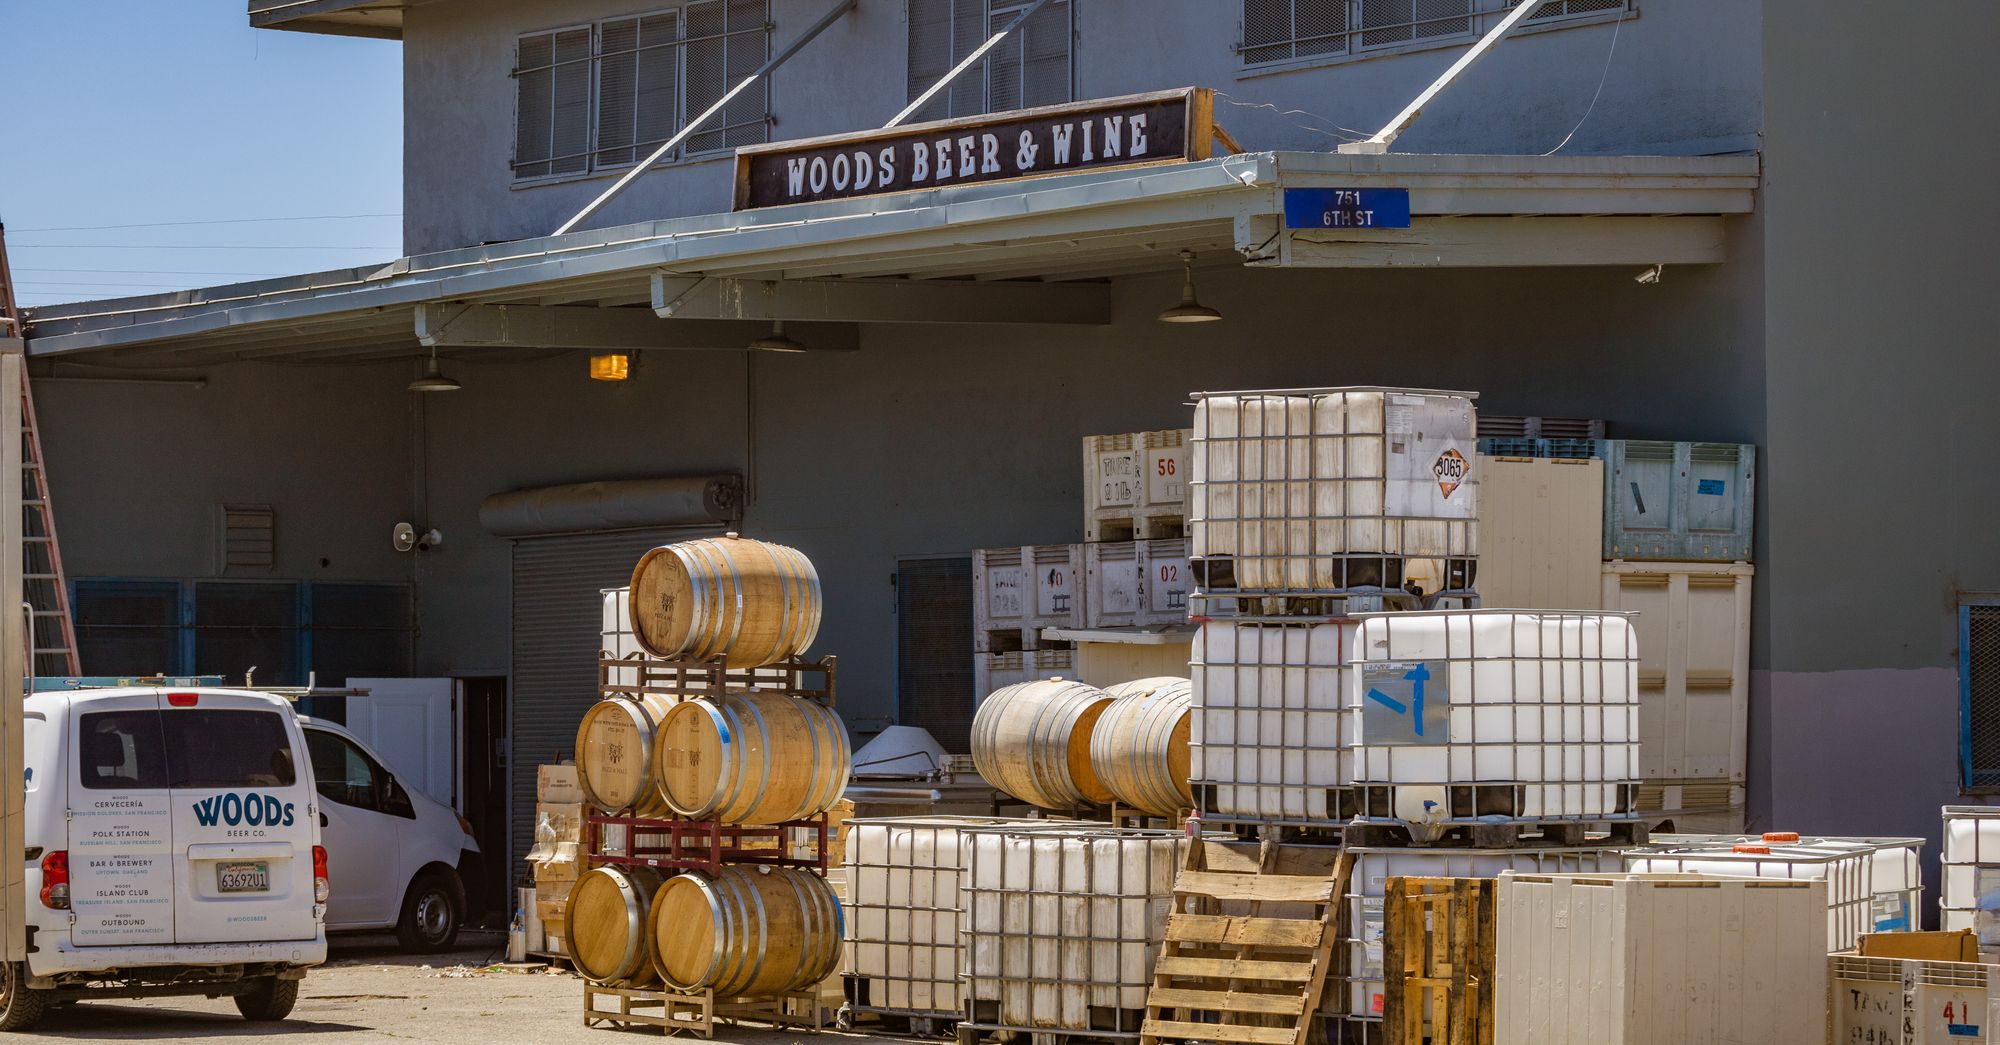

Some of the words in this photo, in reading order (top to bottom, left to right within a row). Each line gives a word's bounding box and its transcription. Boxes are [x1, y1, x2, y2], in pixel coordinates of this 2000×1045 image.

[788, 146, 896, 196] WOODS
[912, 133, 1001, 182] BEER
[1016, 129, 1039, 170] &
[1052, 113, 1147, 165] WINE
[1335, 191, 1360, 206] 751
[1323, 210, 1351, 226] 6TH
[1356, 210, 1373, 226] ST
[1158, 458, 1176, 476] 56
[1437, 457, 1461, 477] 3065
[1161, 565, 1177, 582] 02
[95, 800, 143, 808] CERVECERÍA
[192, 792, 295, 827] WOODS
[222, 873, 266, 888] 63692U1
